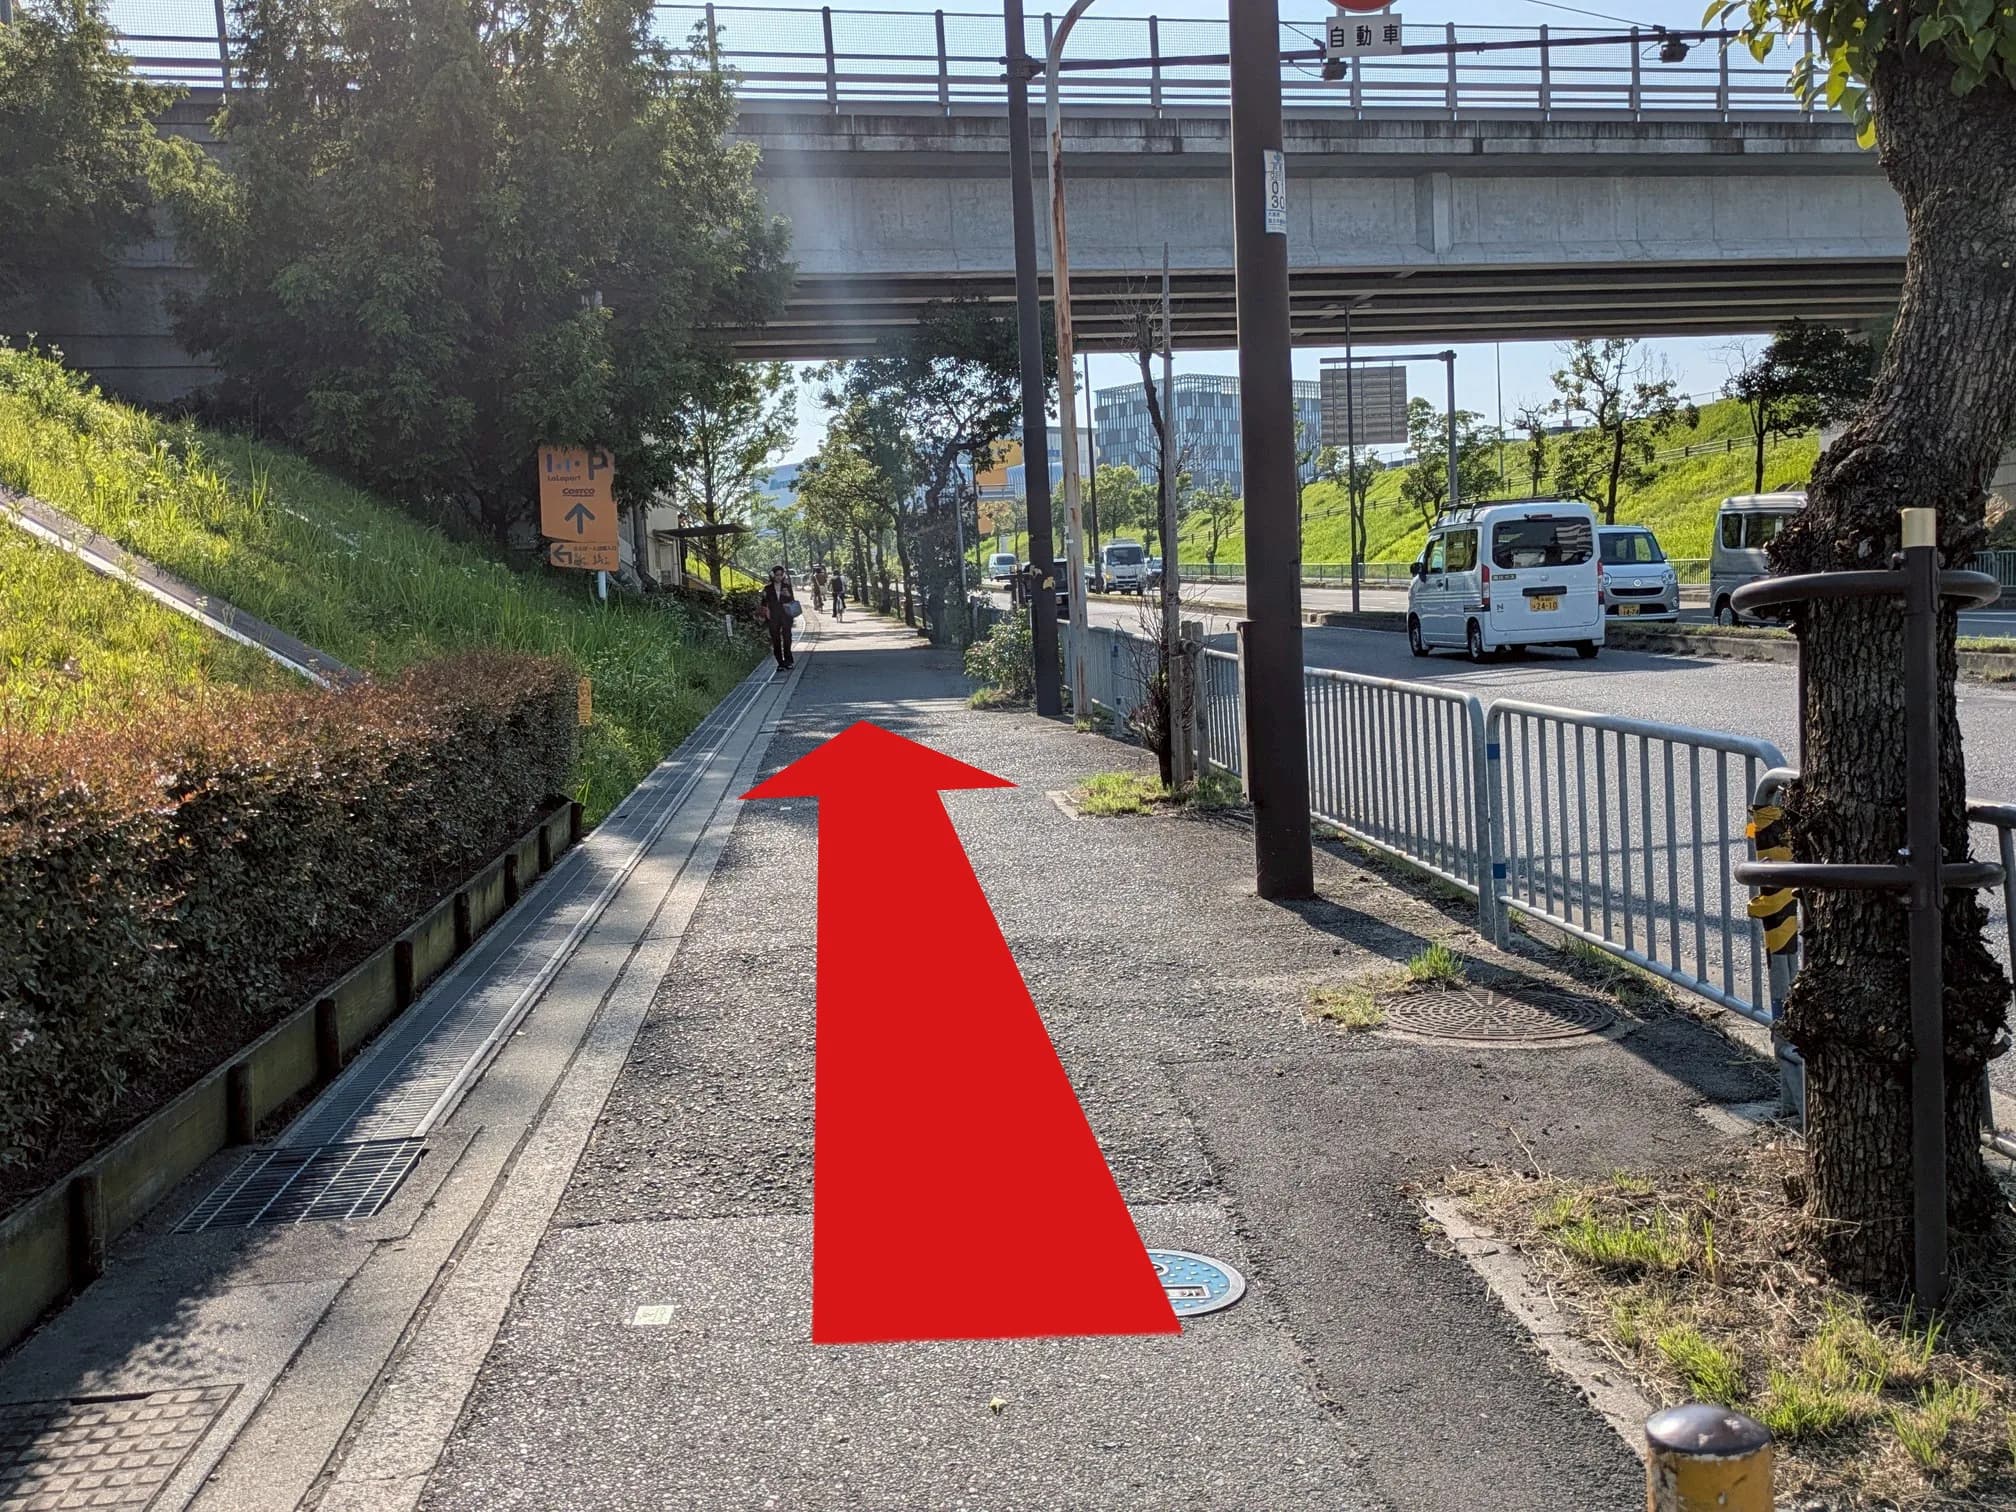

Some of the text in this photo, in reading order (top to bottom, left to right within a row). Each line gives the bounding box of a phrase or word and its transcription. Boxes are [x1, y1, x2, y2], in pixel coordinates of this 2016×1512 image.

[1330, 24, 1399, 48] 自動車
[588, 450, 608, 480] P
